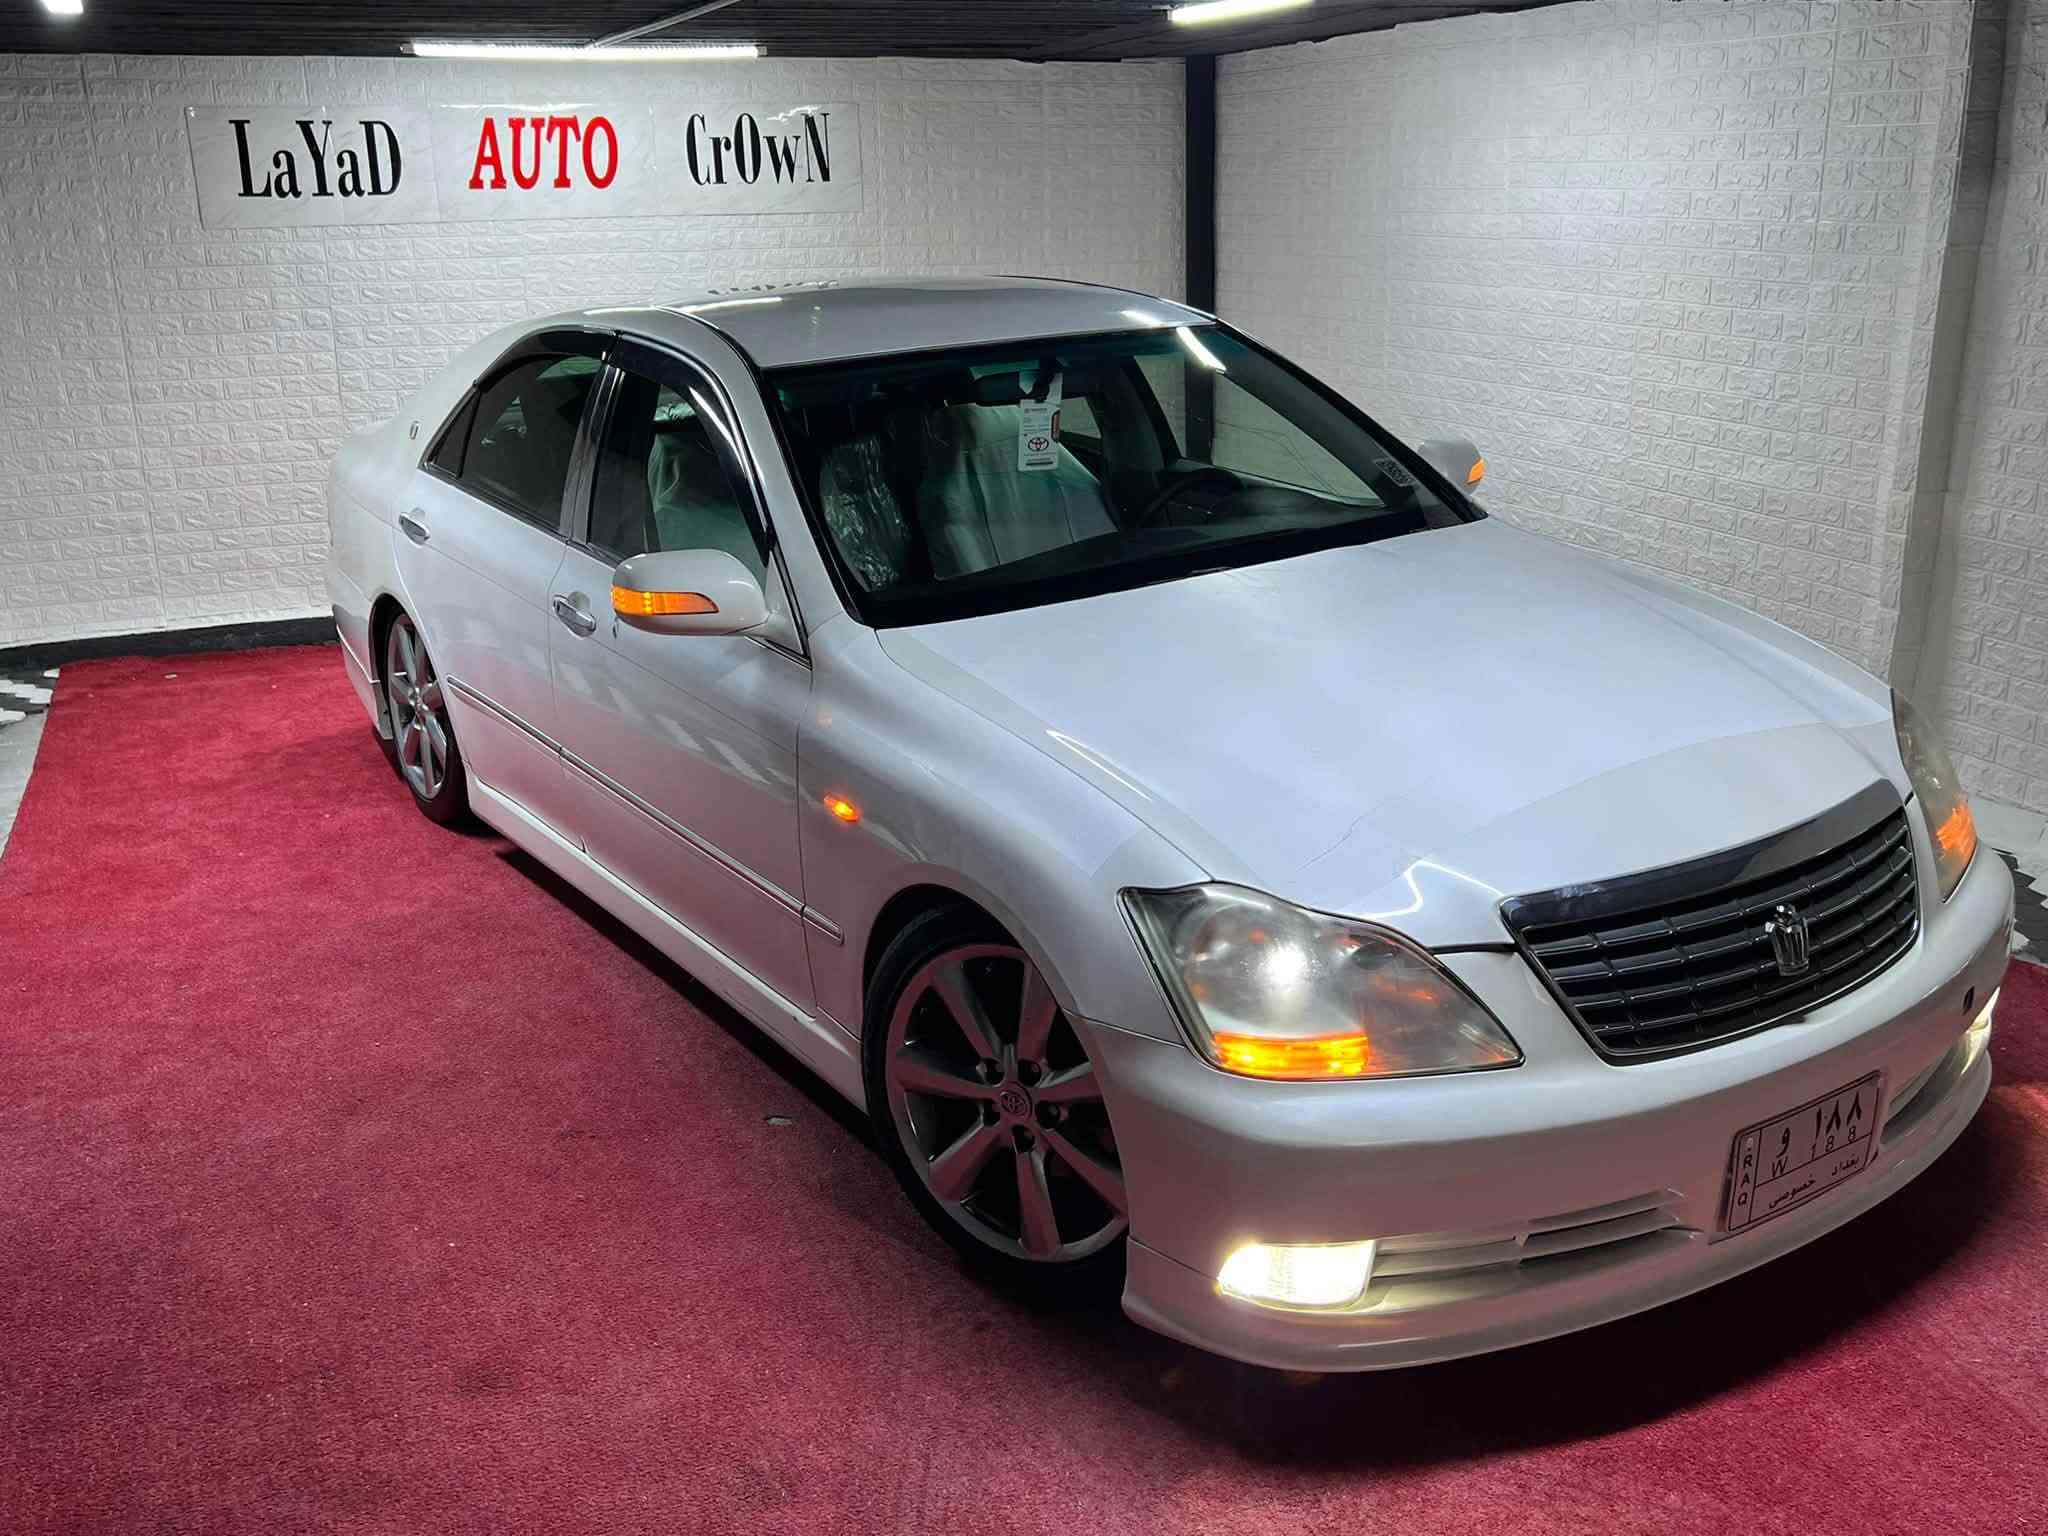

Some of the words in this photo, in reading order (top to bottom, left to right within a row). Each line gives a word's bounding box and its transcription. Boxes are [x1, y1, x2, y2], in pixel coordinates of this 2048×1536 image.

[229, 120, 402, 198] LaYaD
[468, 116, 619, 190] AUTO
[1772, 1156, 1788, 1177] W
[1812, 1125, 1857, 1160] 188
